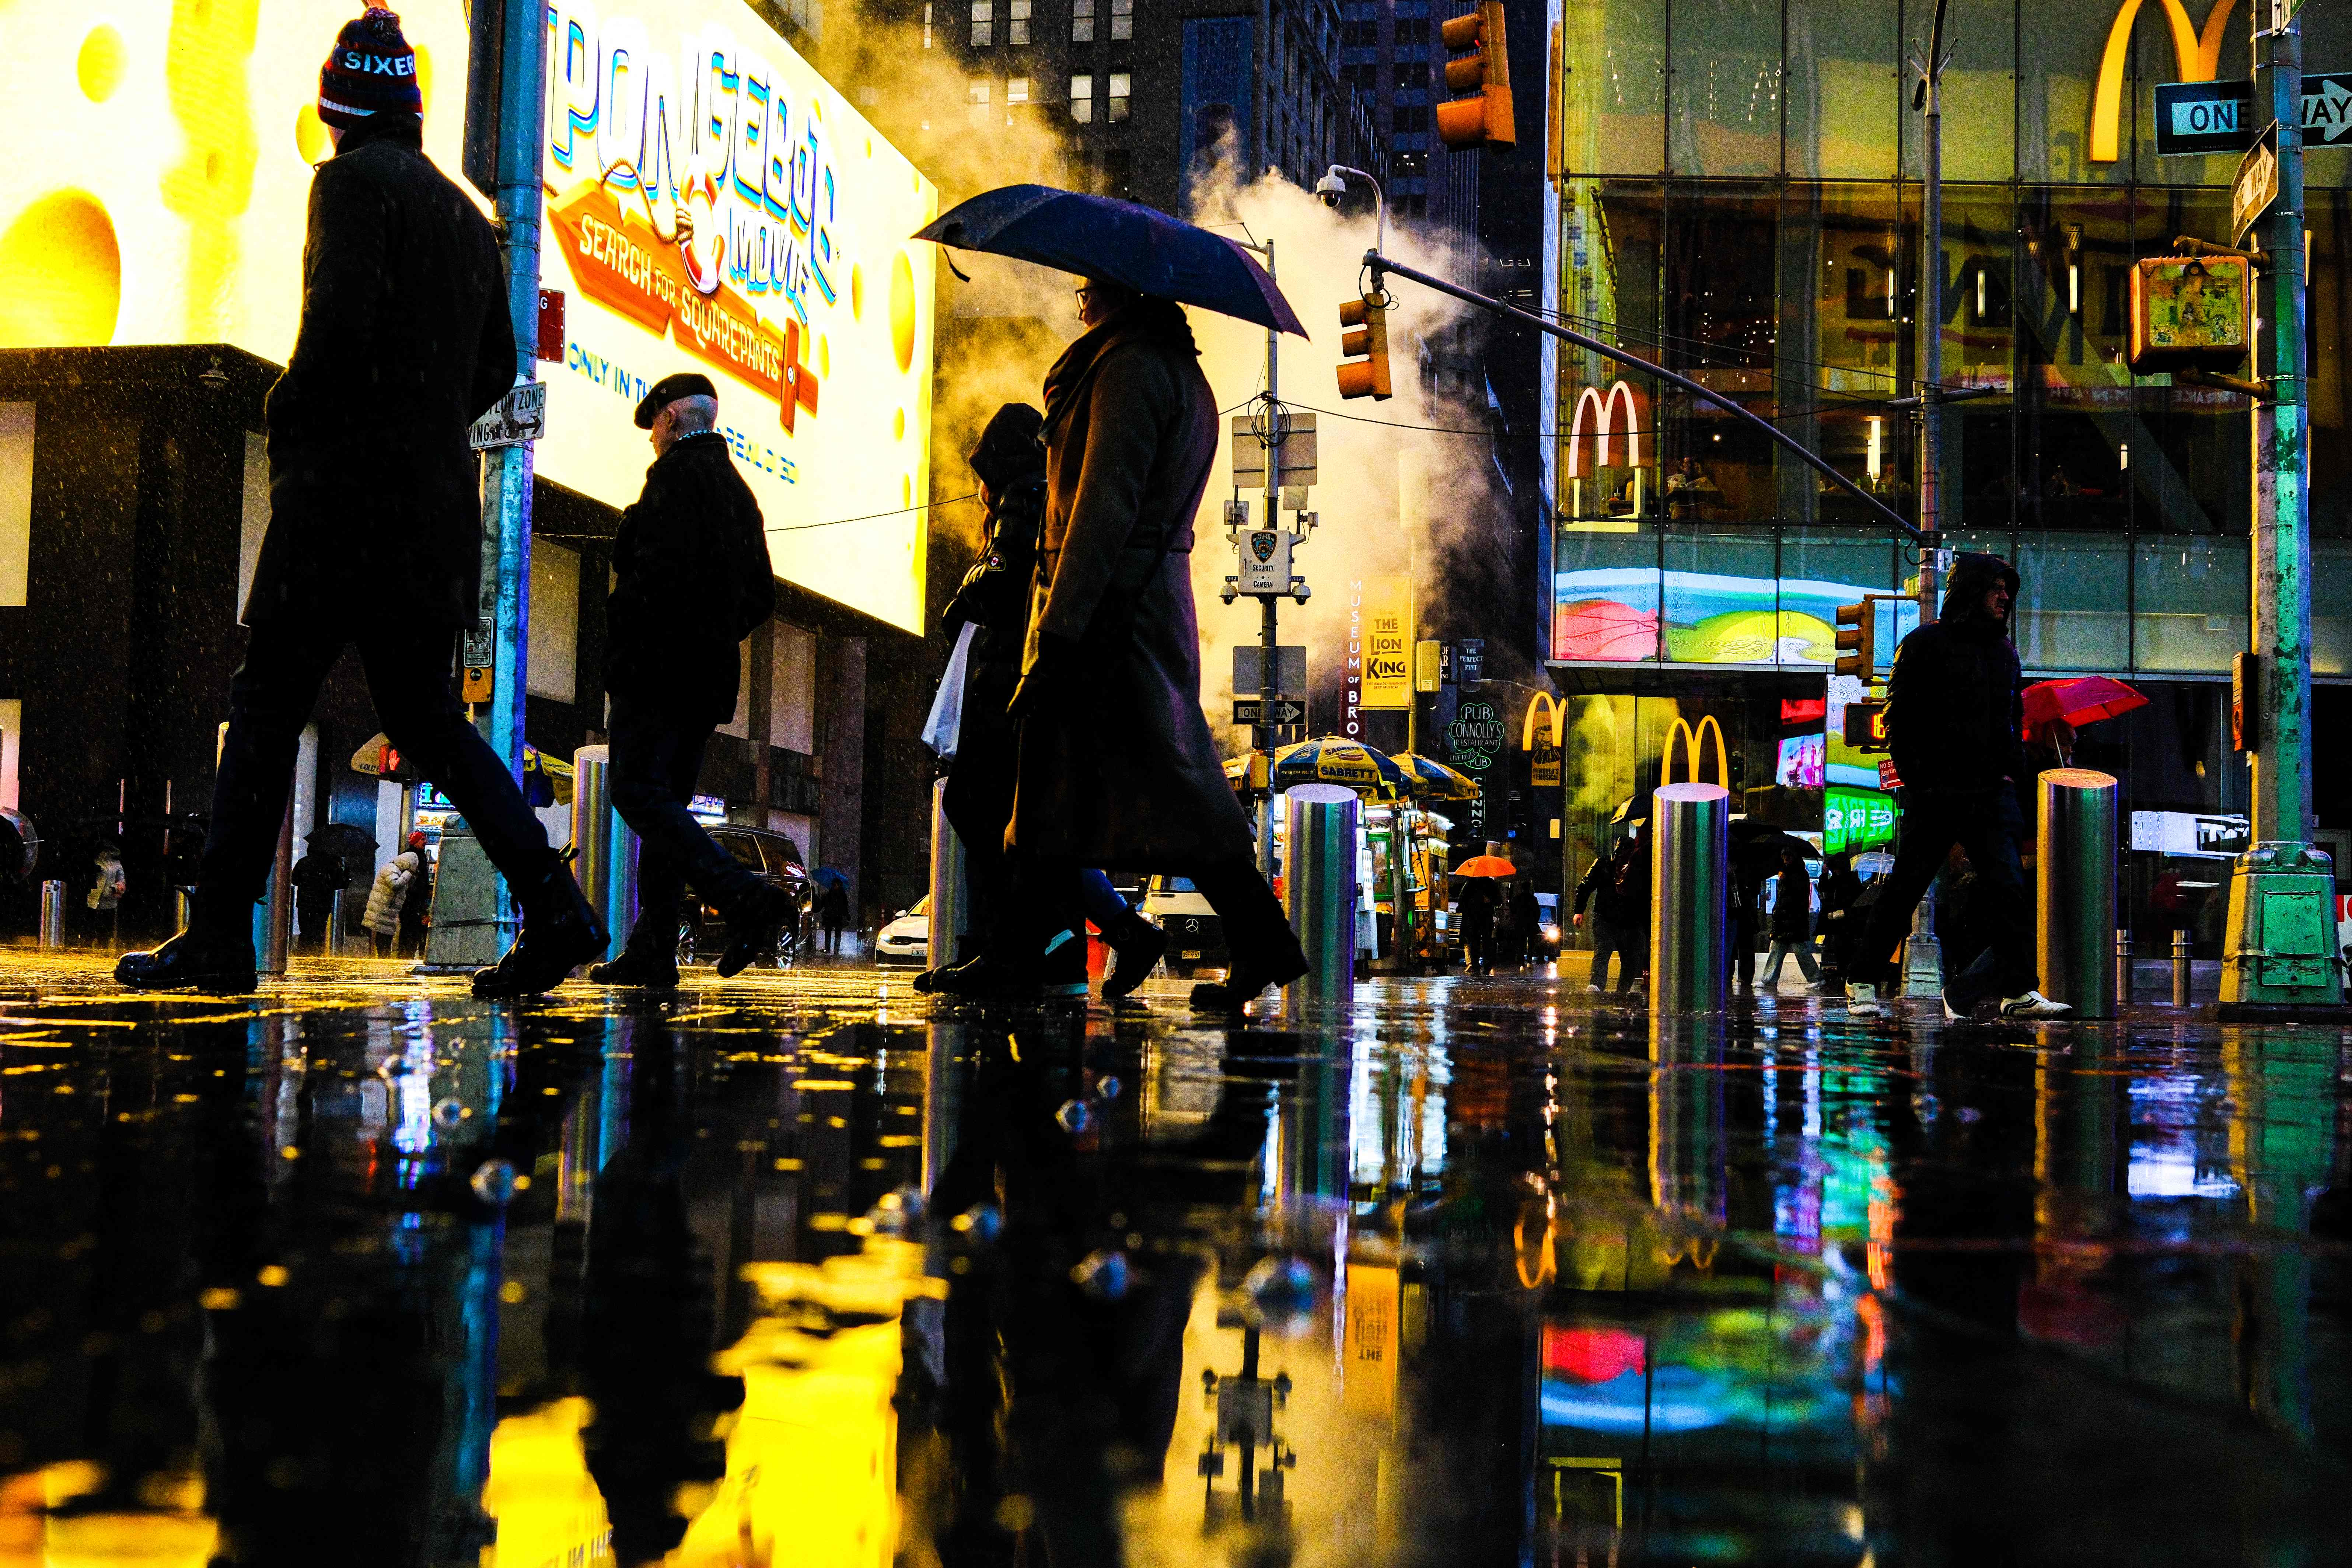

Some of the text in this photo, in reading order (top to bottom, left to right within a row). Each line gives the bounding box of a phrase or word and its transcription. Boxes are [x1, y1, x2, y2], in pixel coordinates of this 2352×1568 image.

[2190, 102, 2250, 131] ONE
[548, 2, 838, 303] PONGEBOB
[2251, 154, 2268, 198] WAY
[579, 212, 676, 308] SEARCH FOR
[729, 200, 809, 325] MOVIE
[681, 285, 779, 382] SQUAREPANTS
[569, 343, 652, 404] ONLY IN TH
[518, 387, 544, 410] ZONE
[1348, 580, 1362, 669] MUSEUM
[1374, 618, 1398, 629] THE
[1347, 690, 1359, 741] BRO
[1451, 722, 1501, 738] CONNOLLY'S
[1465, 706, 1490, 720] PUB
[1320, 766, 1376, 779] SABRETT
